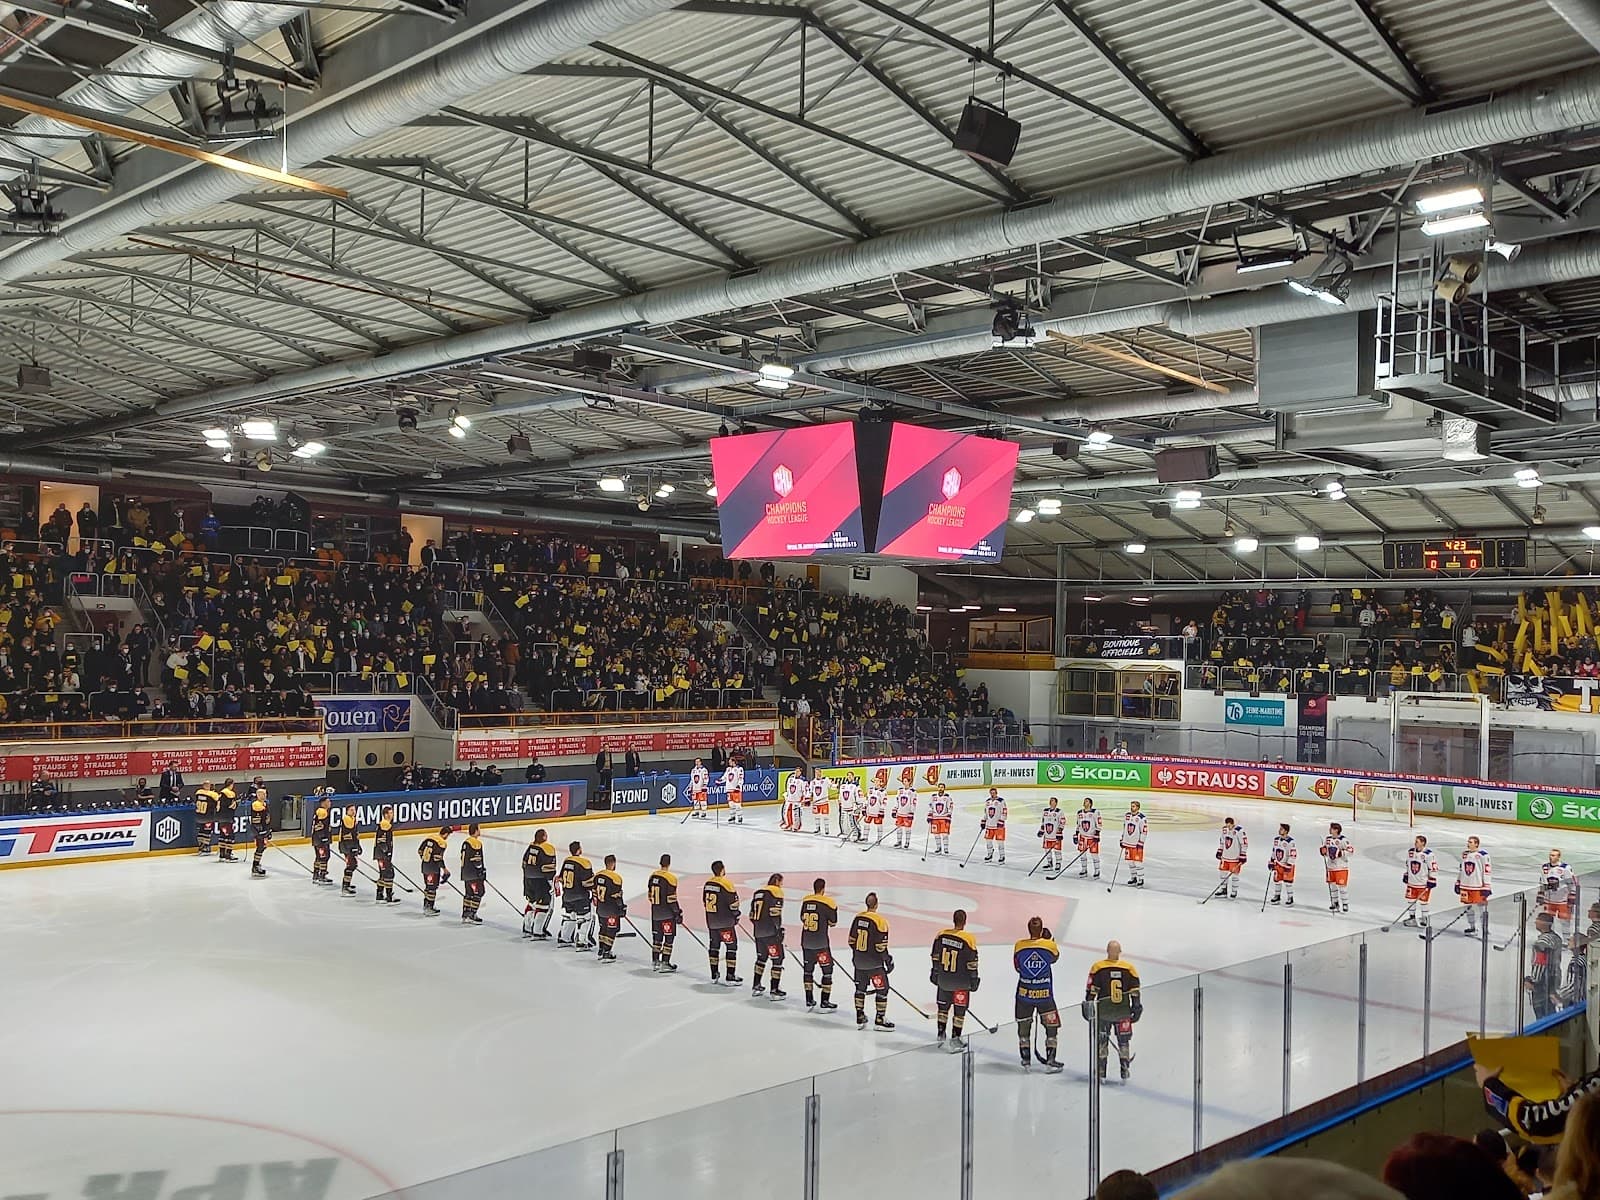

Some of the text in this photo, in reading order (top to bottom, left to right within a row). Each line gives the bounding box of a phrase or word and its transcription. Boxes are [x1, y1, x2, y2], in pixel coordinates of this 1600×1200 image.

[765, 501, 807, 515] CHAMPIONS
[928, 503, 966, 518] CHAMPIONS
[767, 513, 808, 524] HOCKEY LEAGUE
[927, 515, 964, 527] HOCKEY LEAGUE
[1430, 559, 1437, 569] 0
[1470, 558, 1477, 569] 0
[1102, 639, 1141, 649] BOUTIQUE
[1101, 648, 1144, 657] OFFICIELLE
[1228, 703, 1241, 719] 76
[1245, 706, 1283, 716] SEINE-MARITIME
[95, 753, 128, 761] STRAUSS
[1071, 764, 1141, 781] ŠKODA
[1174, 769, 1259, 791] STRAUSS
[438, 796, 501, 820] HOCKEY
[505, 792, 562, 815] LEAGUE
[1457, 795, 1513, 811] APH-INVEST
[58, 830, 137, 843] RADIAL
[157, 818, 180, 842] CHL
[941, 947, 959, 973] 41
[1027, 960, 1042, 969] LGT
[1110, 979, 1123, 1004] 6
